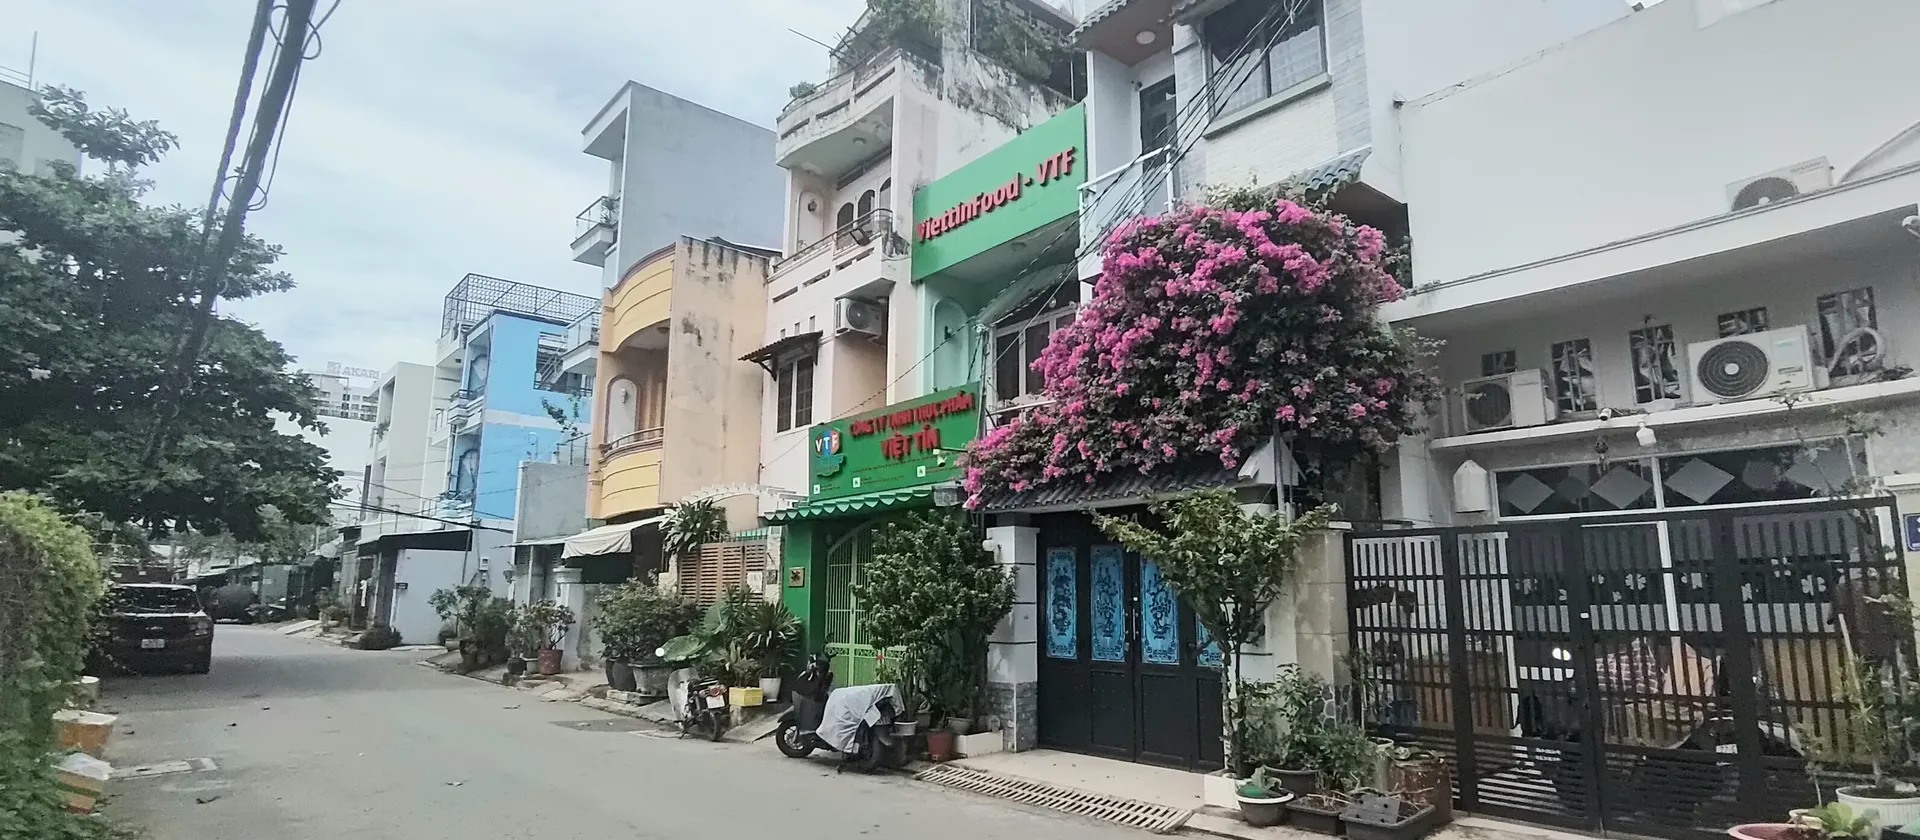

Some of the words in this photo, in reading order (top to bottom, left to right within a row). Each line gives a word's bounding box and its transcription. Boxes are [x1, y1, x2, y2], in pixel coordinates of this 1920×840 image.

[1035, 146, 1077, 187] VTF
[815, 433, 839, 453] VTF
[880, 431, 912, 460] VIỆT
